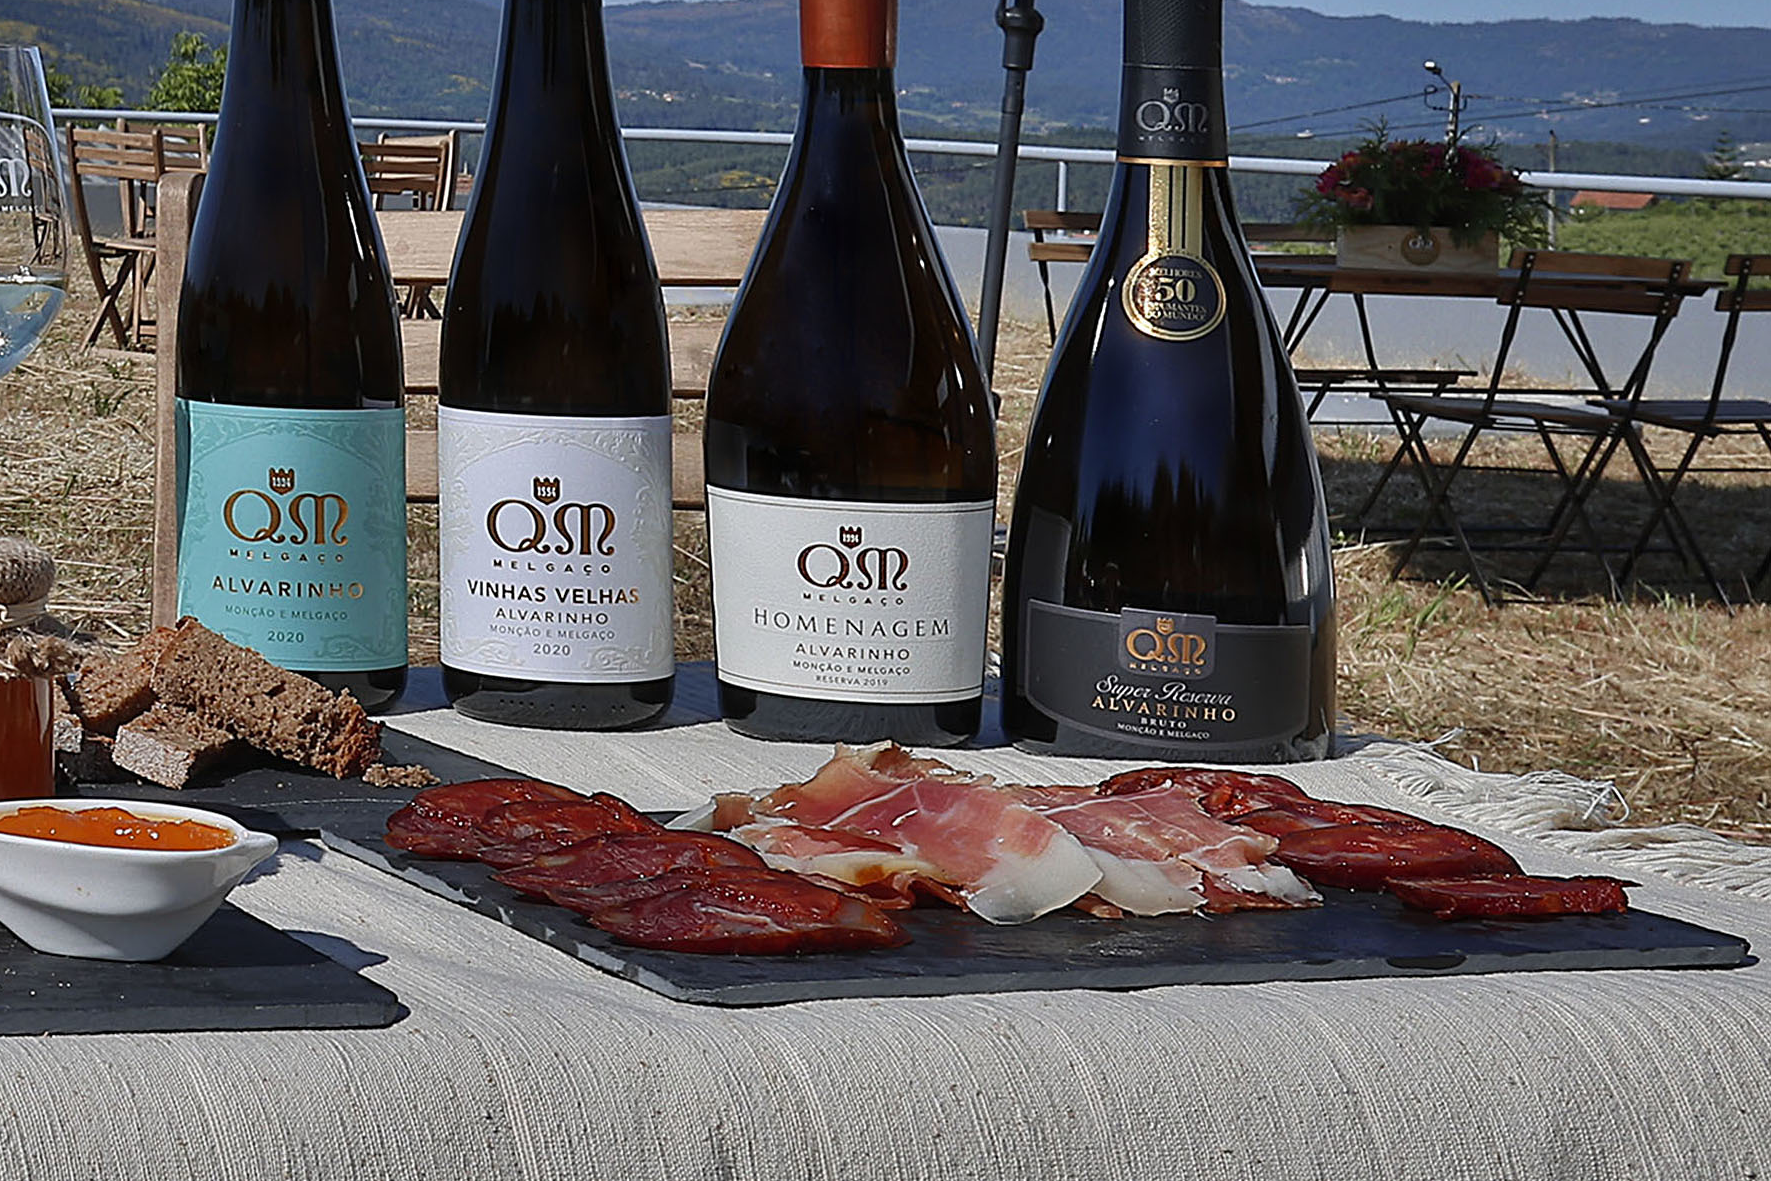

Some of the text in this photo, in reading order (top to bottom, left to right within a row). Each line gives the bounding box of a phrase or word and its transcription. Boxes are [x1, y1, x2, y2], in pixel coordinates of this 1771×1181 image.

[1136, 100, 1207, 132] QM
[1155, 277, 1196, 303] 50
[224, 490, 348, 545] QM
[486, 499, 616, 557] QM
[229, 549, 344, 565] MELGAÇO
[493, 559, 611, 576] MELGAÇO
[797, 544, 910, 592] QM
[212, 575, 365, 599] ALVARINHO
[467, 579, 640, 604] VINHAS VELHAS
[803, 592, 904, 607] MELGAÇO
[280, 610, 288, 619] E
[292, 611, 348, 621] MELGAÇO
[495, 607, 608, 625] ALVARINHO
[754, 607, 951, 638] HOMENAGEM
[268, 630, 305, 643] 2020
[489, 624, 615, 640] MONÇÃO E MELGAÇO
[533, 643, 571, 656] 2020
[796, 643, 910, 661] ALVARINHO
[1126, 628, 1207, 667] QM
[793, 660, 911, 676] MONÇÃO E MELGAÇO
[816, 675, 889, 687] RESERVA 2019
[1096, 674, 1234, 706] Super Reserva
[1091, 695, 1237, 722] ALVARINHO
[1117, 722, 1211, 739] MONÇÃO E MELGAÇO
[1140, 717, 1188, 729] BRUTO
